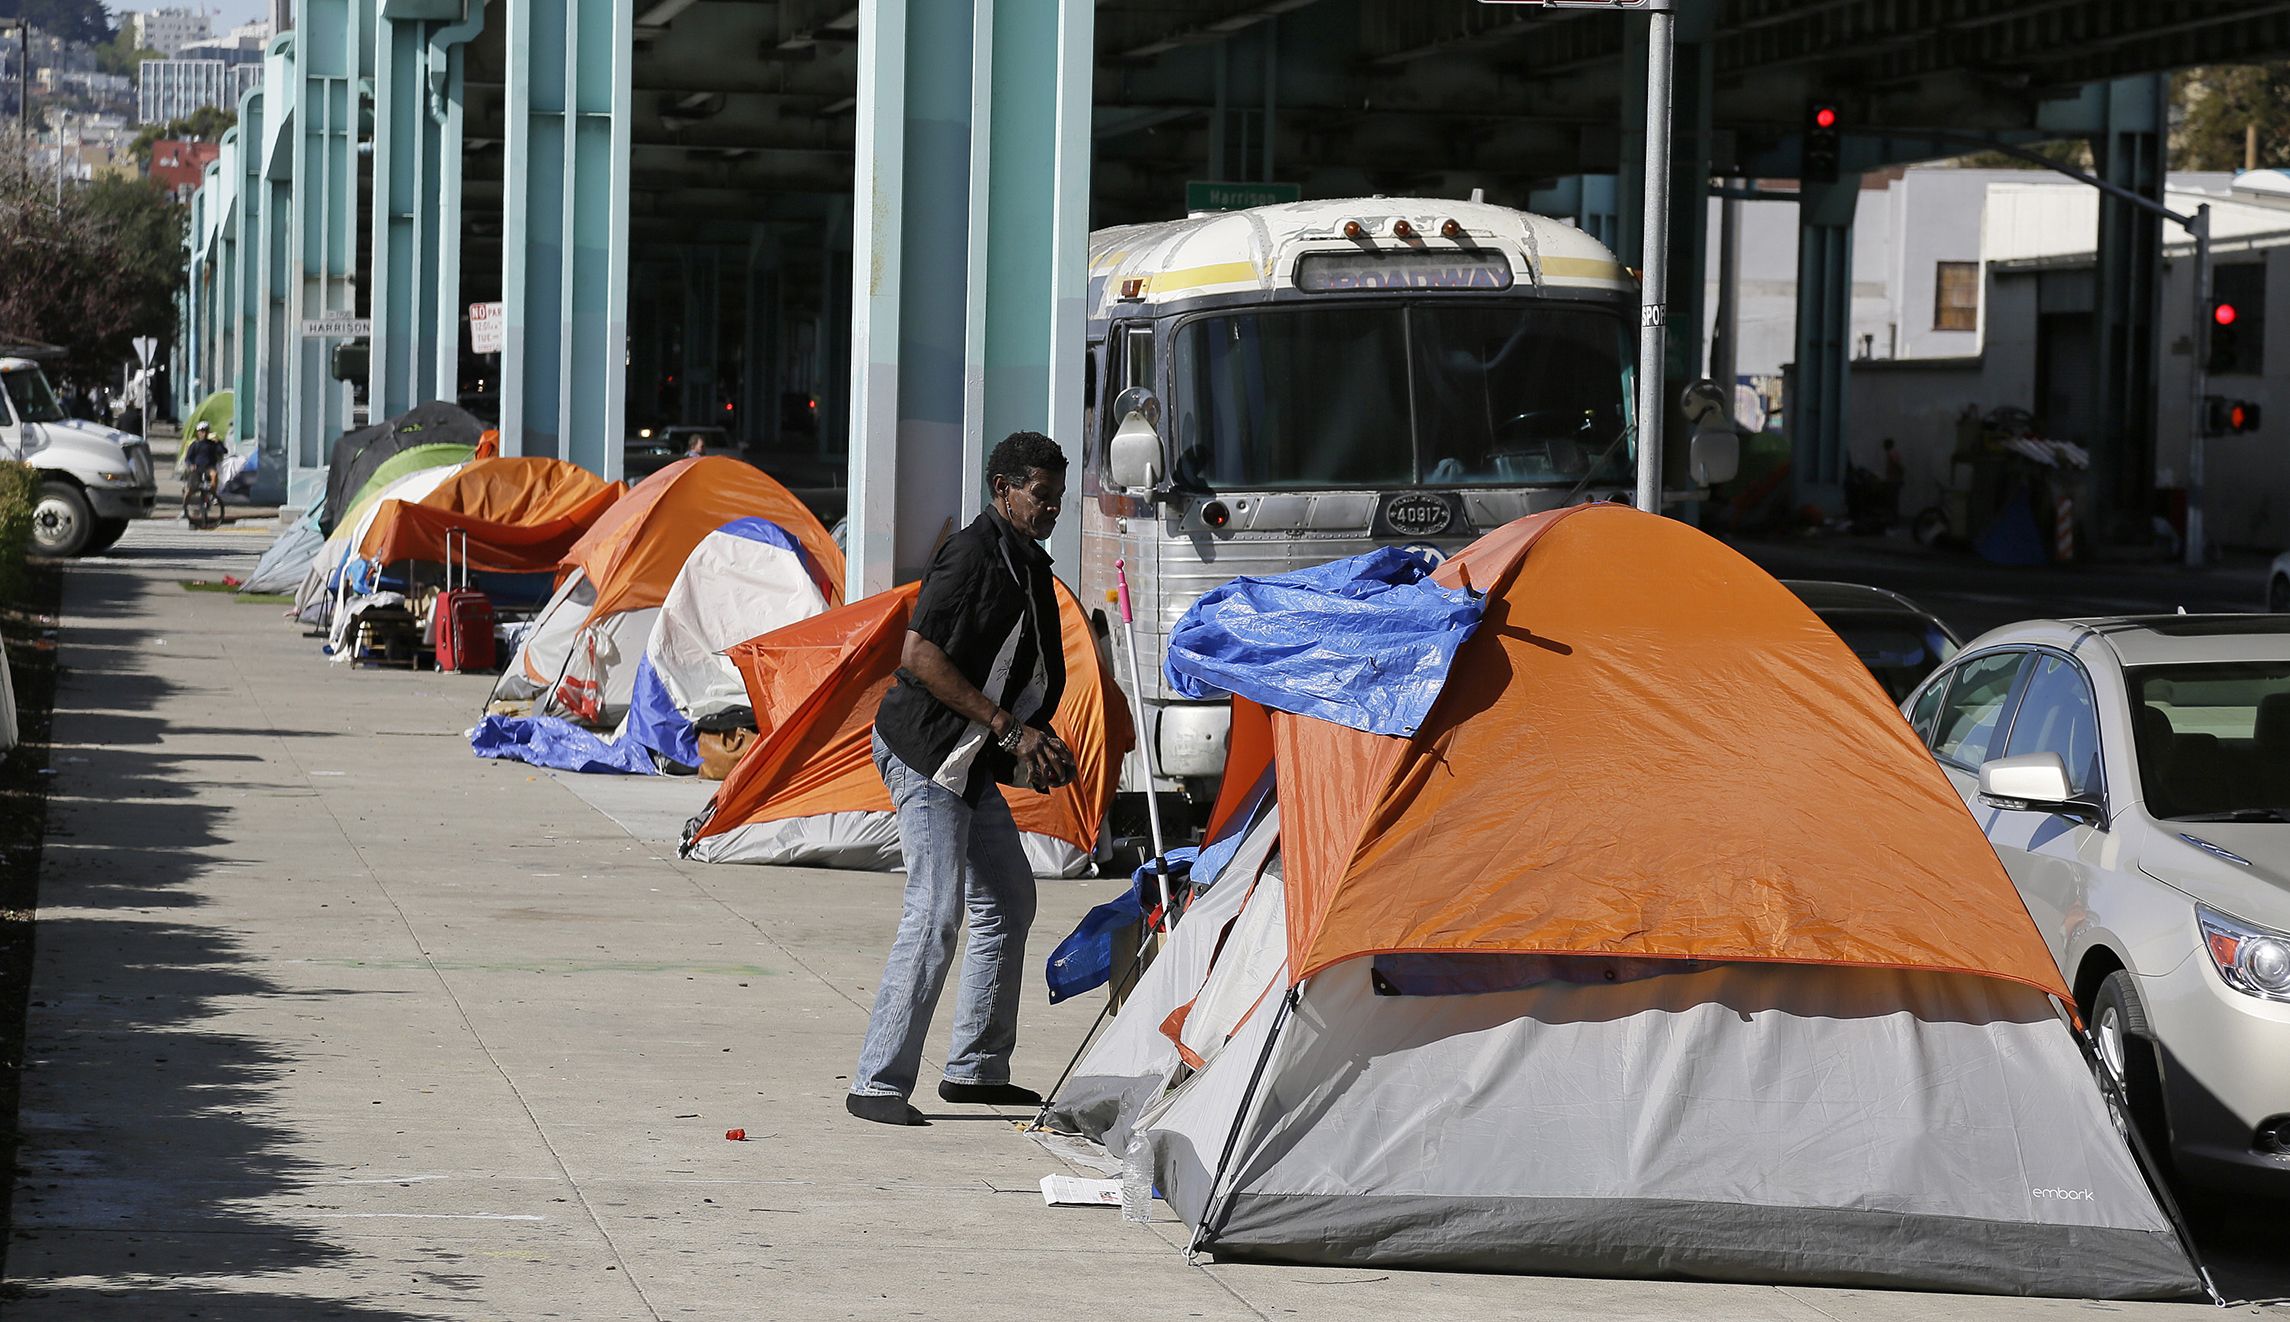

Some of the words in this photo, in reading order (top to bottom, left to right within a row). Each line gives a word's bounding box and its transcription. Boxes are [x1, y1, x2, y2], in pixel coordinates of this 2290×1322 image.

[1210, 189, 1277, 205] Harrison
[472, 306, 486, 320] NO
[309, 322, 371, 333] HARRISON
[1397, 507, 1440, 522] 40917
[2032, 1186, 2095, 1201] embark
